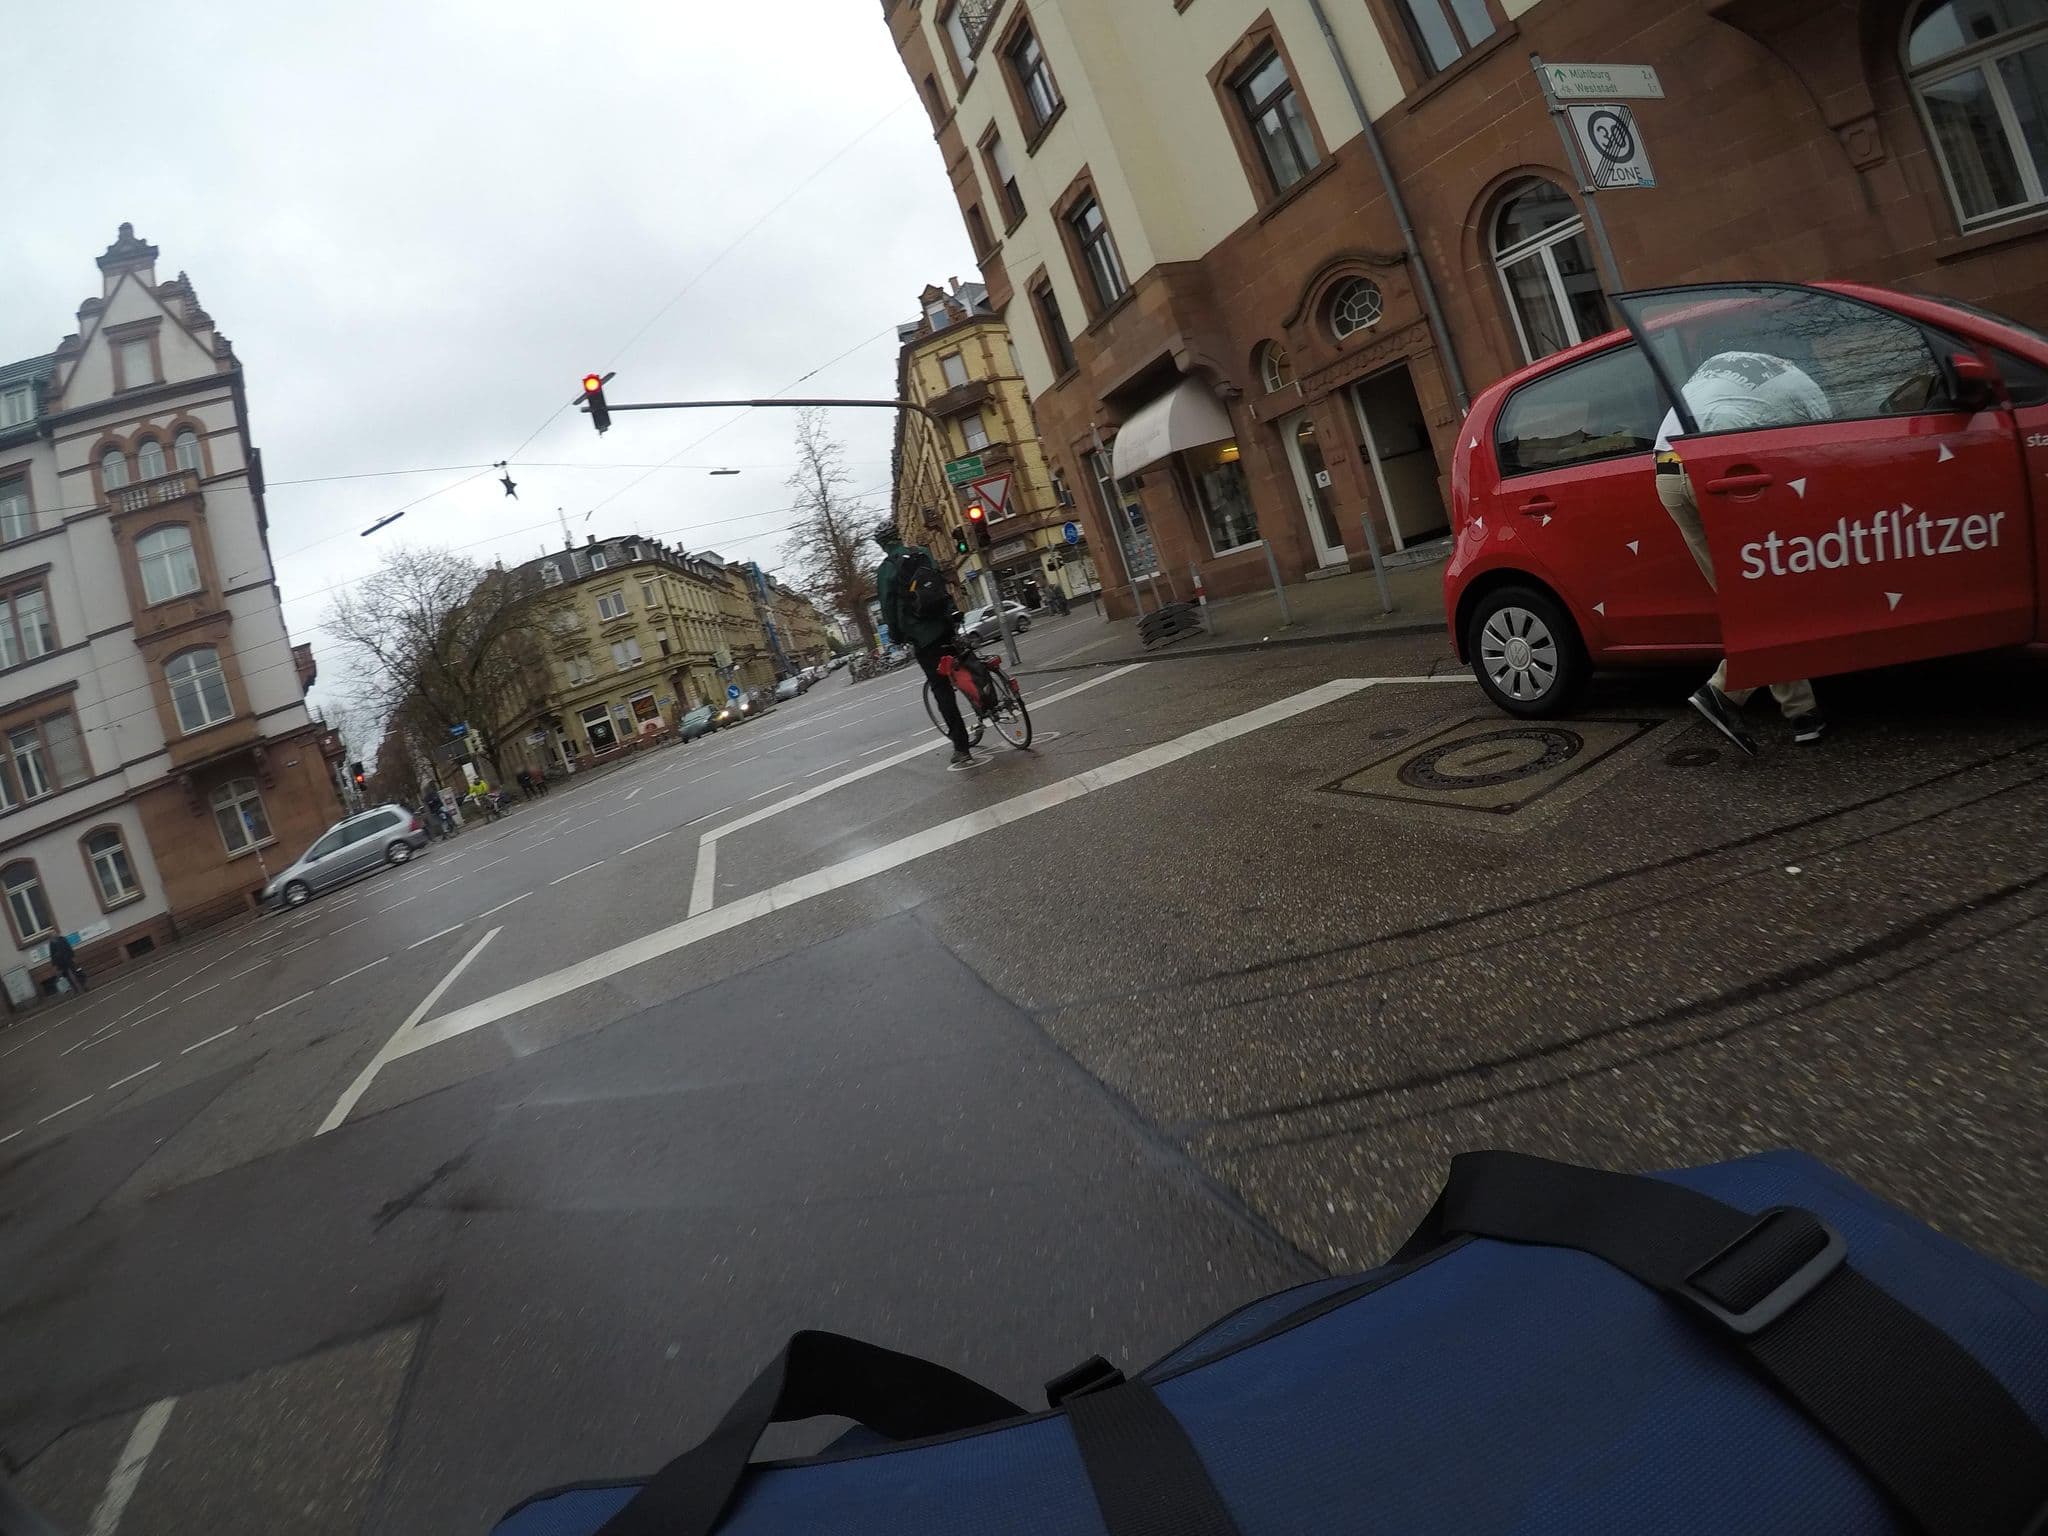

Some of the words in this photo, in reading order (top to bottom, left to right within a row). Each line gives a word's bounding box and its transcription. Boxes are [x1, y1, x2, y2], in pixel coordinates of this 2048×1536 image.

[1568, 68, 1611, 81] Mühlburg
[1574, 82, 1618, 93] Weststadt
[1597, 124, 1628, 149] 30
[1609, 166, 1642, 182] ZONE
[1740, 504, 2006, 580] stadtflitzer
